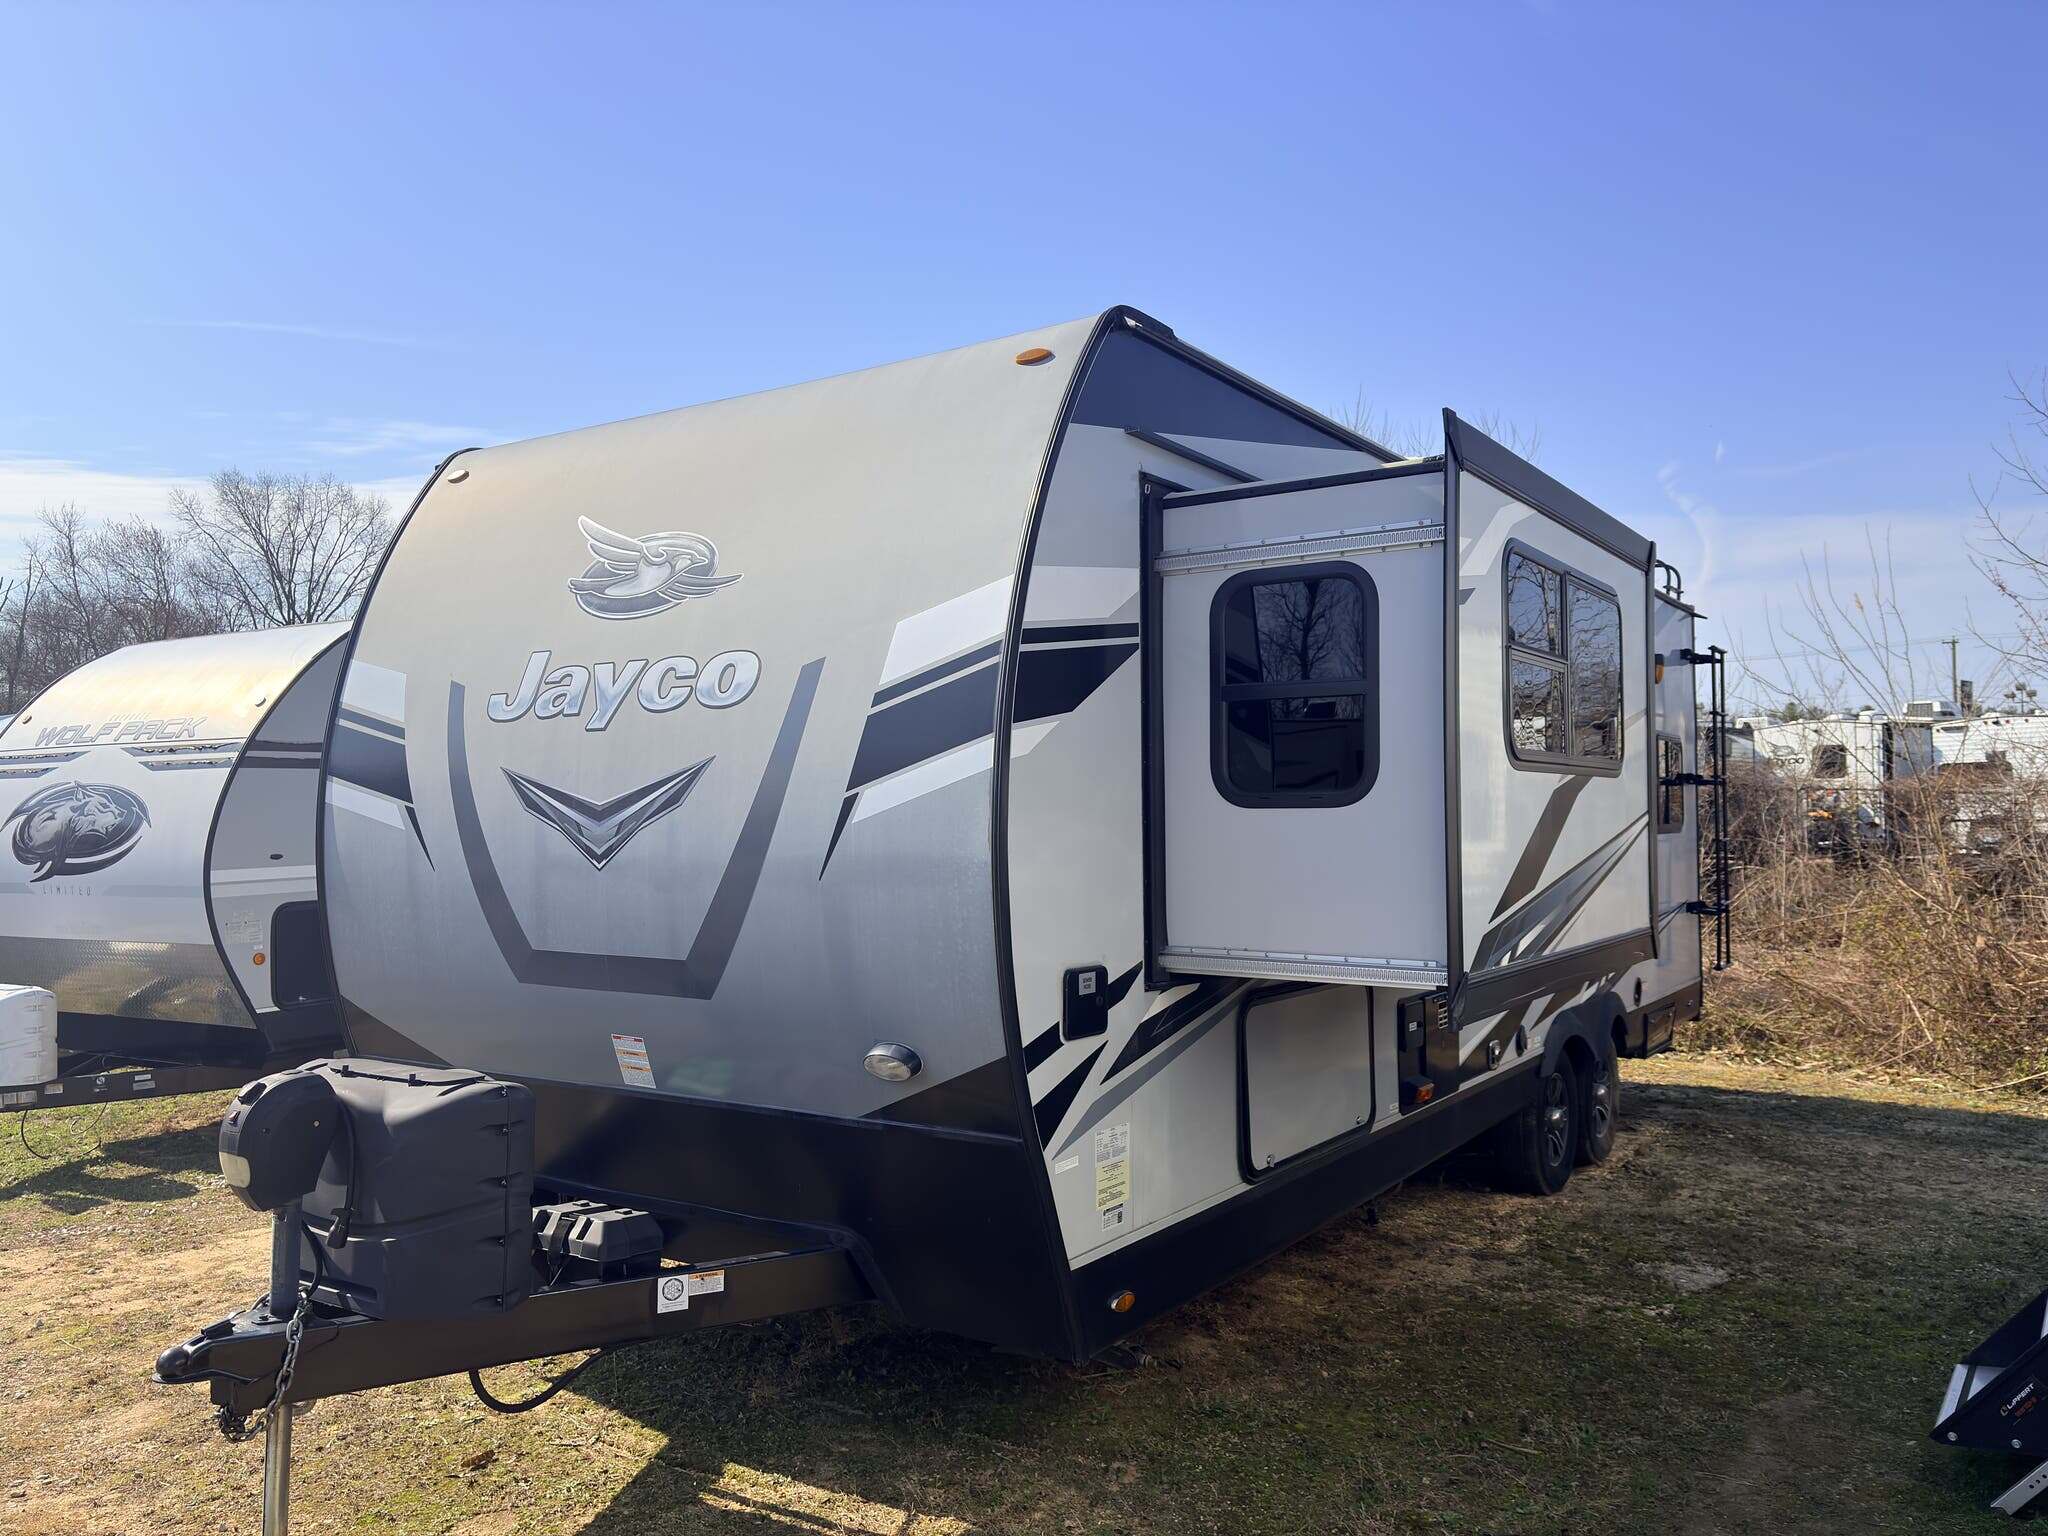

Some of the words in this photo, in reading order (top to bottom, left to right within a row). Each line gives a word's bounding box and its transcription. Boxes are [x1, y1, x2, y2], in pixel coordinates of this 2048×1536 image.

[487, 650, 762, 732] Jayco
[35, 722, 120, 746] WOLF
[114, 716, 208, 741] PACK
[42, 885, 94, 896] LIMITED
